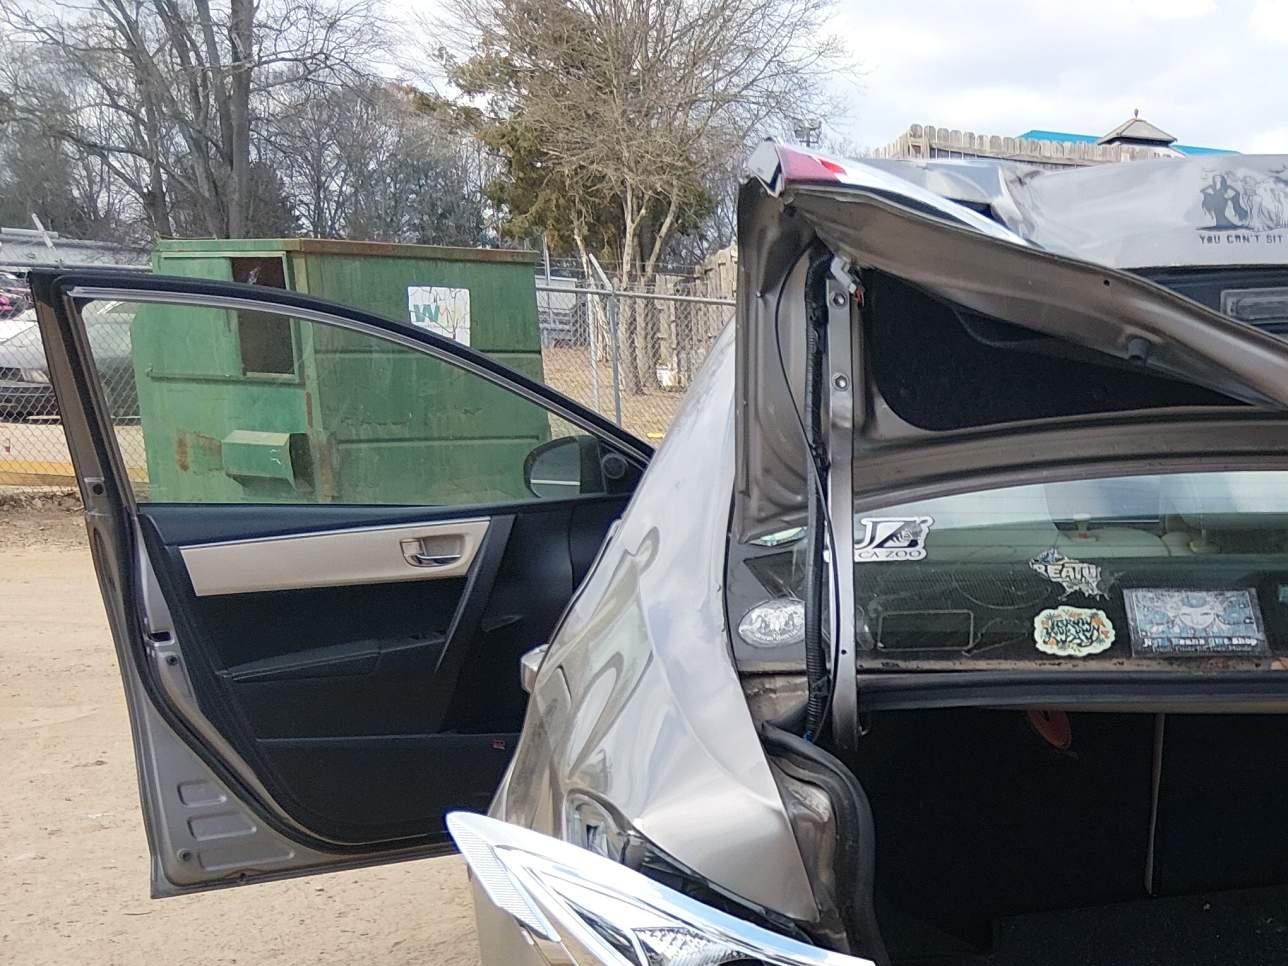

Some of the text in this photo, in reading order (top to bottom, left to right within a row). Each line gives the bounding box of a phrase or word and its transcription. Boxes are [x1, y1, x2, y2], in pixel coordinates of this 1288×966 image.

[1199, 234, 1221, 244] YOU
[1226, 234, 1260, 244] CAN'T
[1265, 234, 1282, 244] SIT
[885, 549, 922, 559] ZOO
